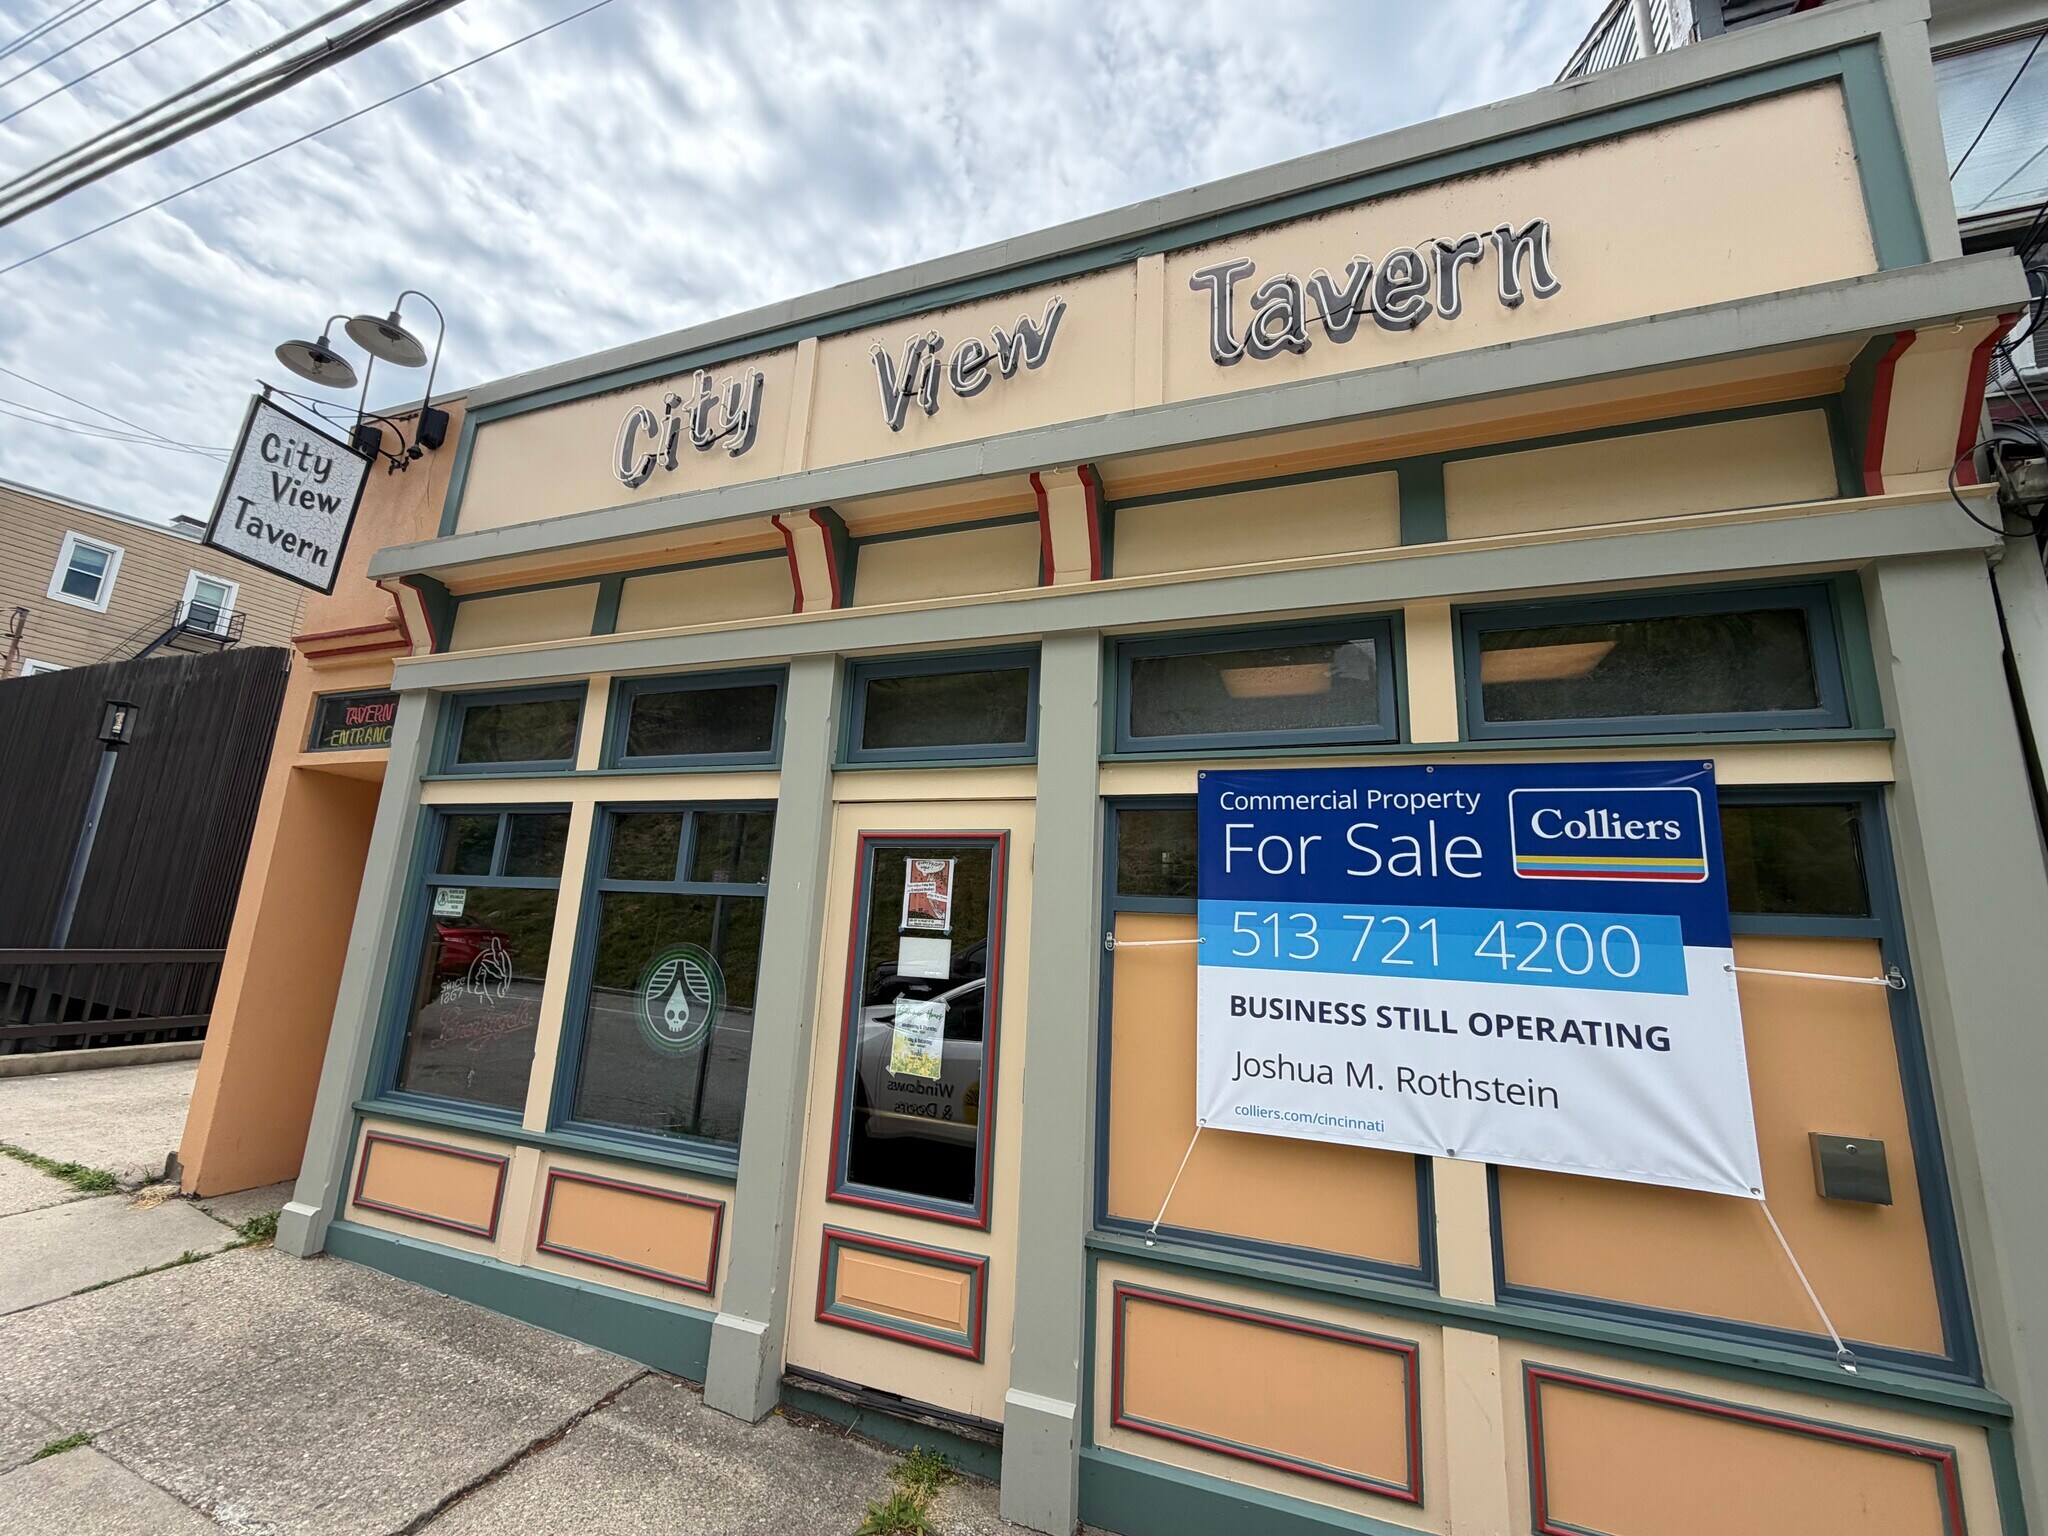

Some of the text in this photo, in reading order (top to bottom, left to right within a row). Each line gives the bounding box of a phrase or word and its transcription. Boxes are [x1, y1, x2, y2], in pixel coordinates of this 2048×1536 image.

[612, 217, 1562, 488] City View Tavern
[261, 433, 332, 484] City
[272, 471, 341, 515] View
[235, 496, 328, 567] Tavern
[329, 725, 393, 747] ENTRANC
[345, 703, 396, 726] TAVERN
[1220, 789, 1481, 815] Commercial Property
[1531, 808, 1681, 840] Colliers
[1225, 819, 1483, 879] For Sale
[1231, 911, 1642, 978] 513 721 4200
[440, 987, 463, 1004] 1867
[1230, 995, 1671, 1052] BUSINESS STILL OPERATING
[1231, 1051, 1559, 1109] Joshua M. Rothstein
[1234, 1104, 1385, 1132] colliers.com/cincinnati
